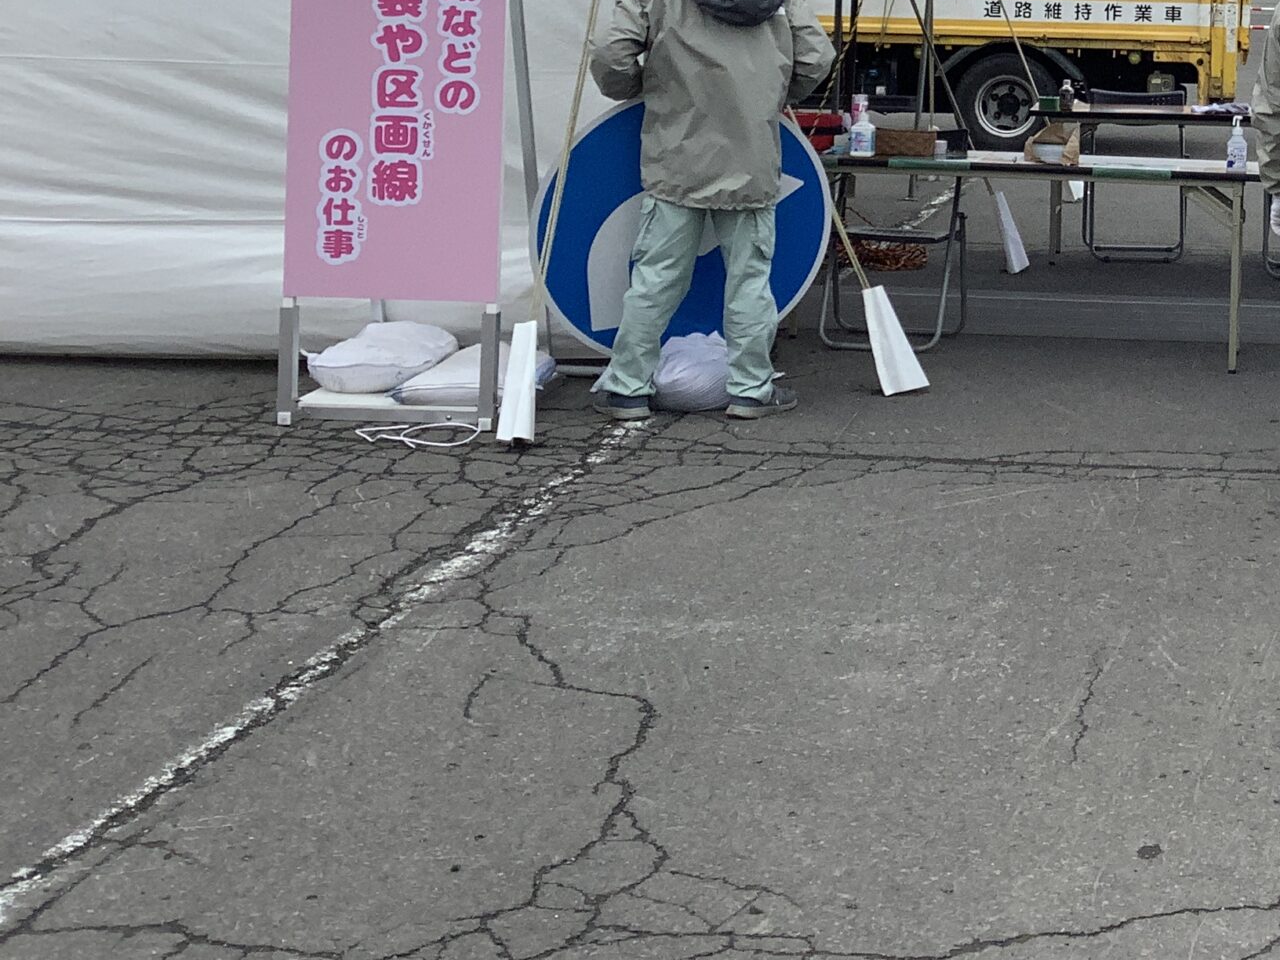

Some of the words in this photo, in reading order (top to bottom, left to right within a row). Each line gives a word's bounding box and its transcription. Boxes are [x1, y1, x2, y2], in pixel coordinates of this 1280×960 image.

[983, 0, 1183, 23] 道路維持作業車
[422, 112, 432, 157] くかくせん
[322, 133, 358, 259] のお仕事
